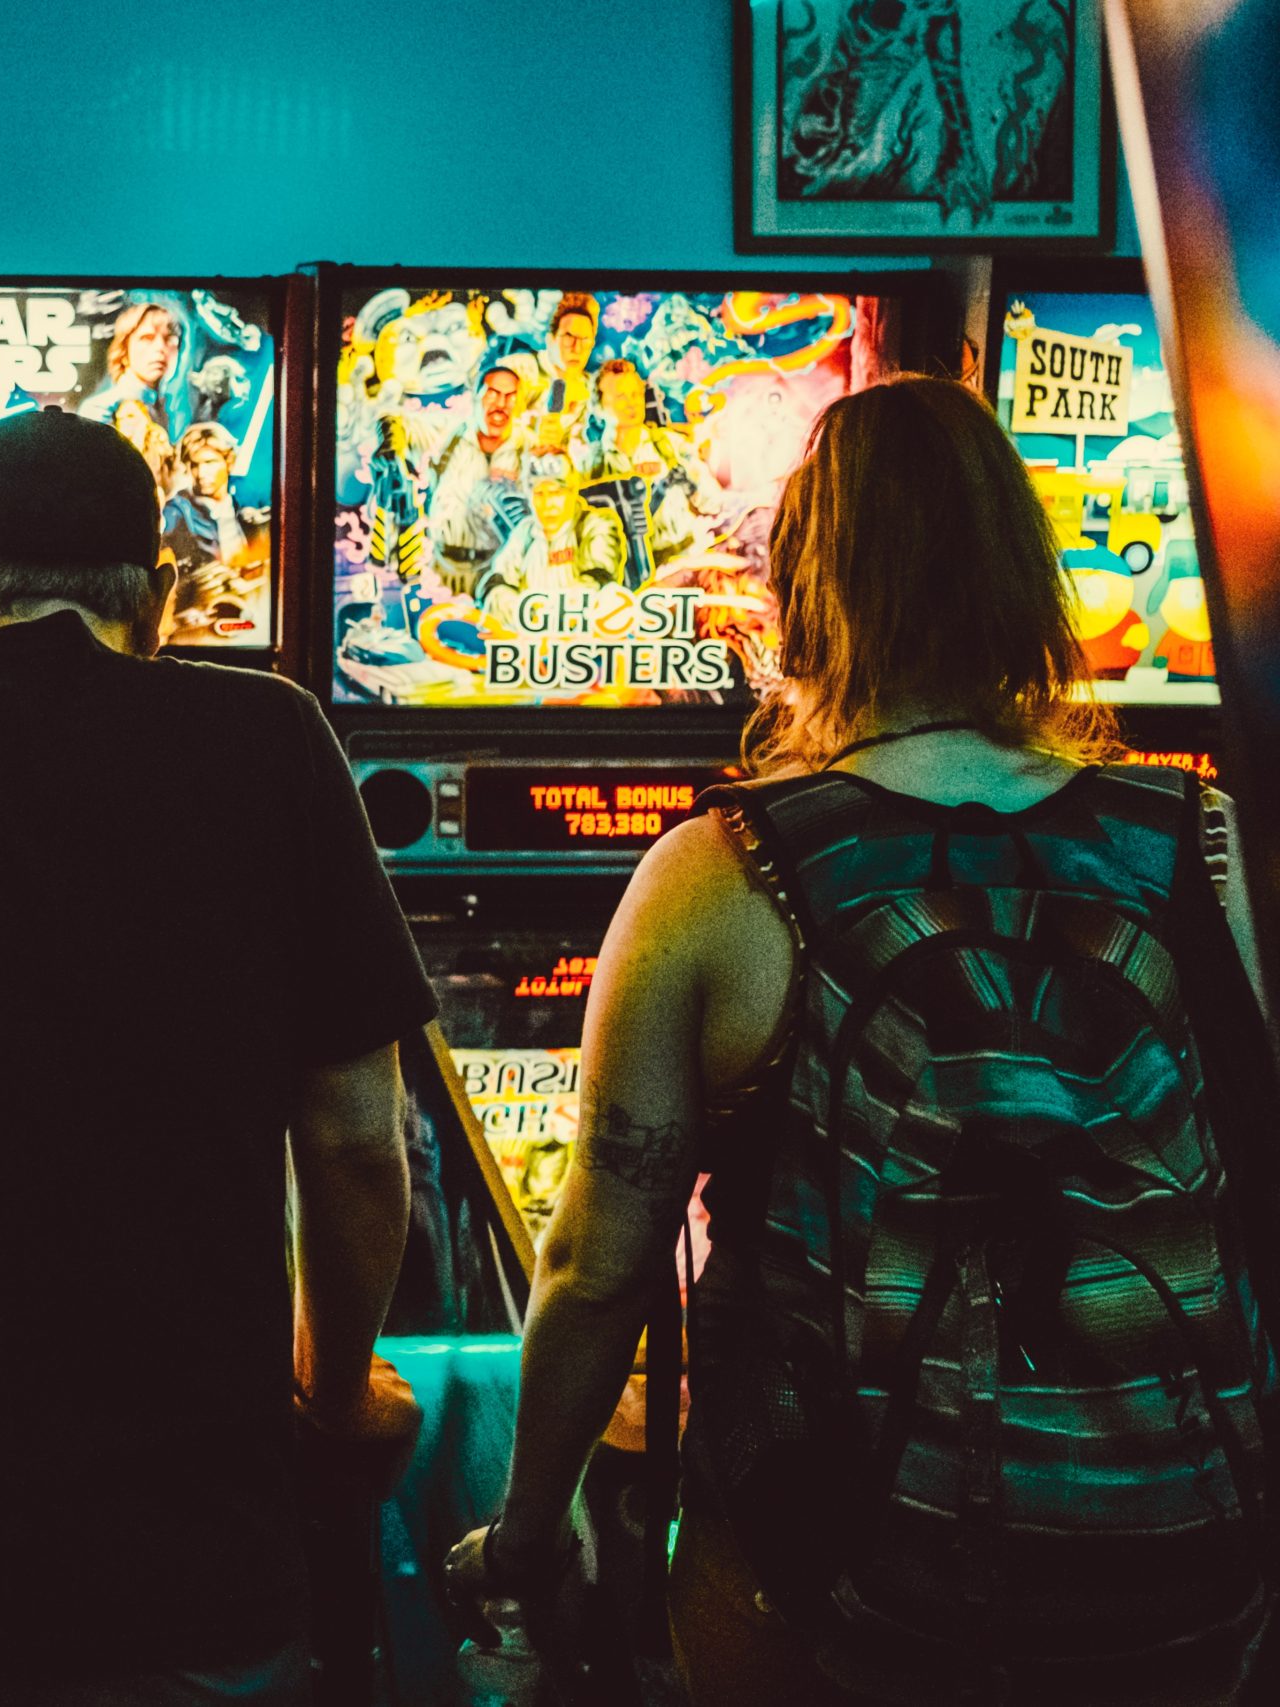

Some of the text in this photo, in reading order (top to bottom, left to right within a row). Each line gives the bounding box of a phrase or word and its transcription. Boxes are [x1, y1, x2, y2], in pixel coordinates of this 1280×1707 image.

[1030, 338, 1122, 386] SOUTH
[1026, 383, 1118, 420] PARK
[489, 644, 729, 685] BUSTERS
[530, 786, 694, 810] TOTAL BONUS
[565, 812, 662, 838] 783,380
